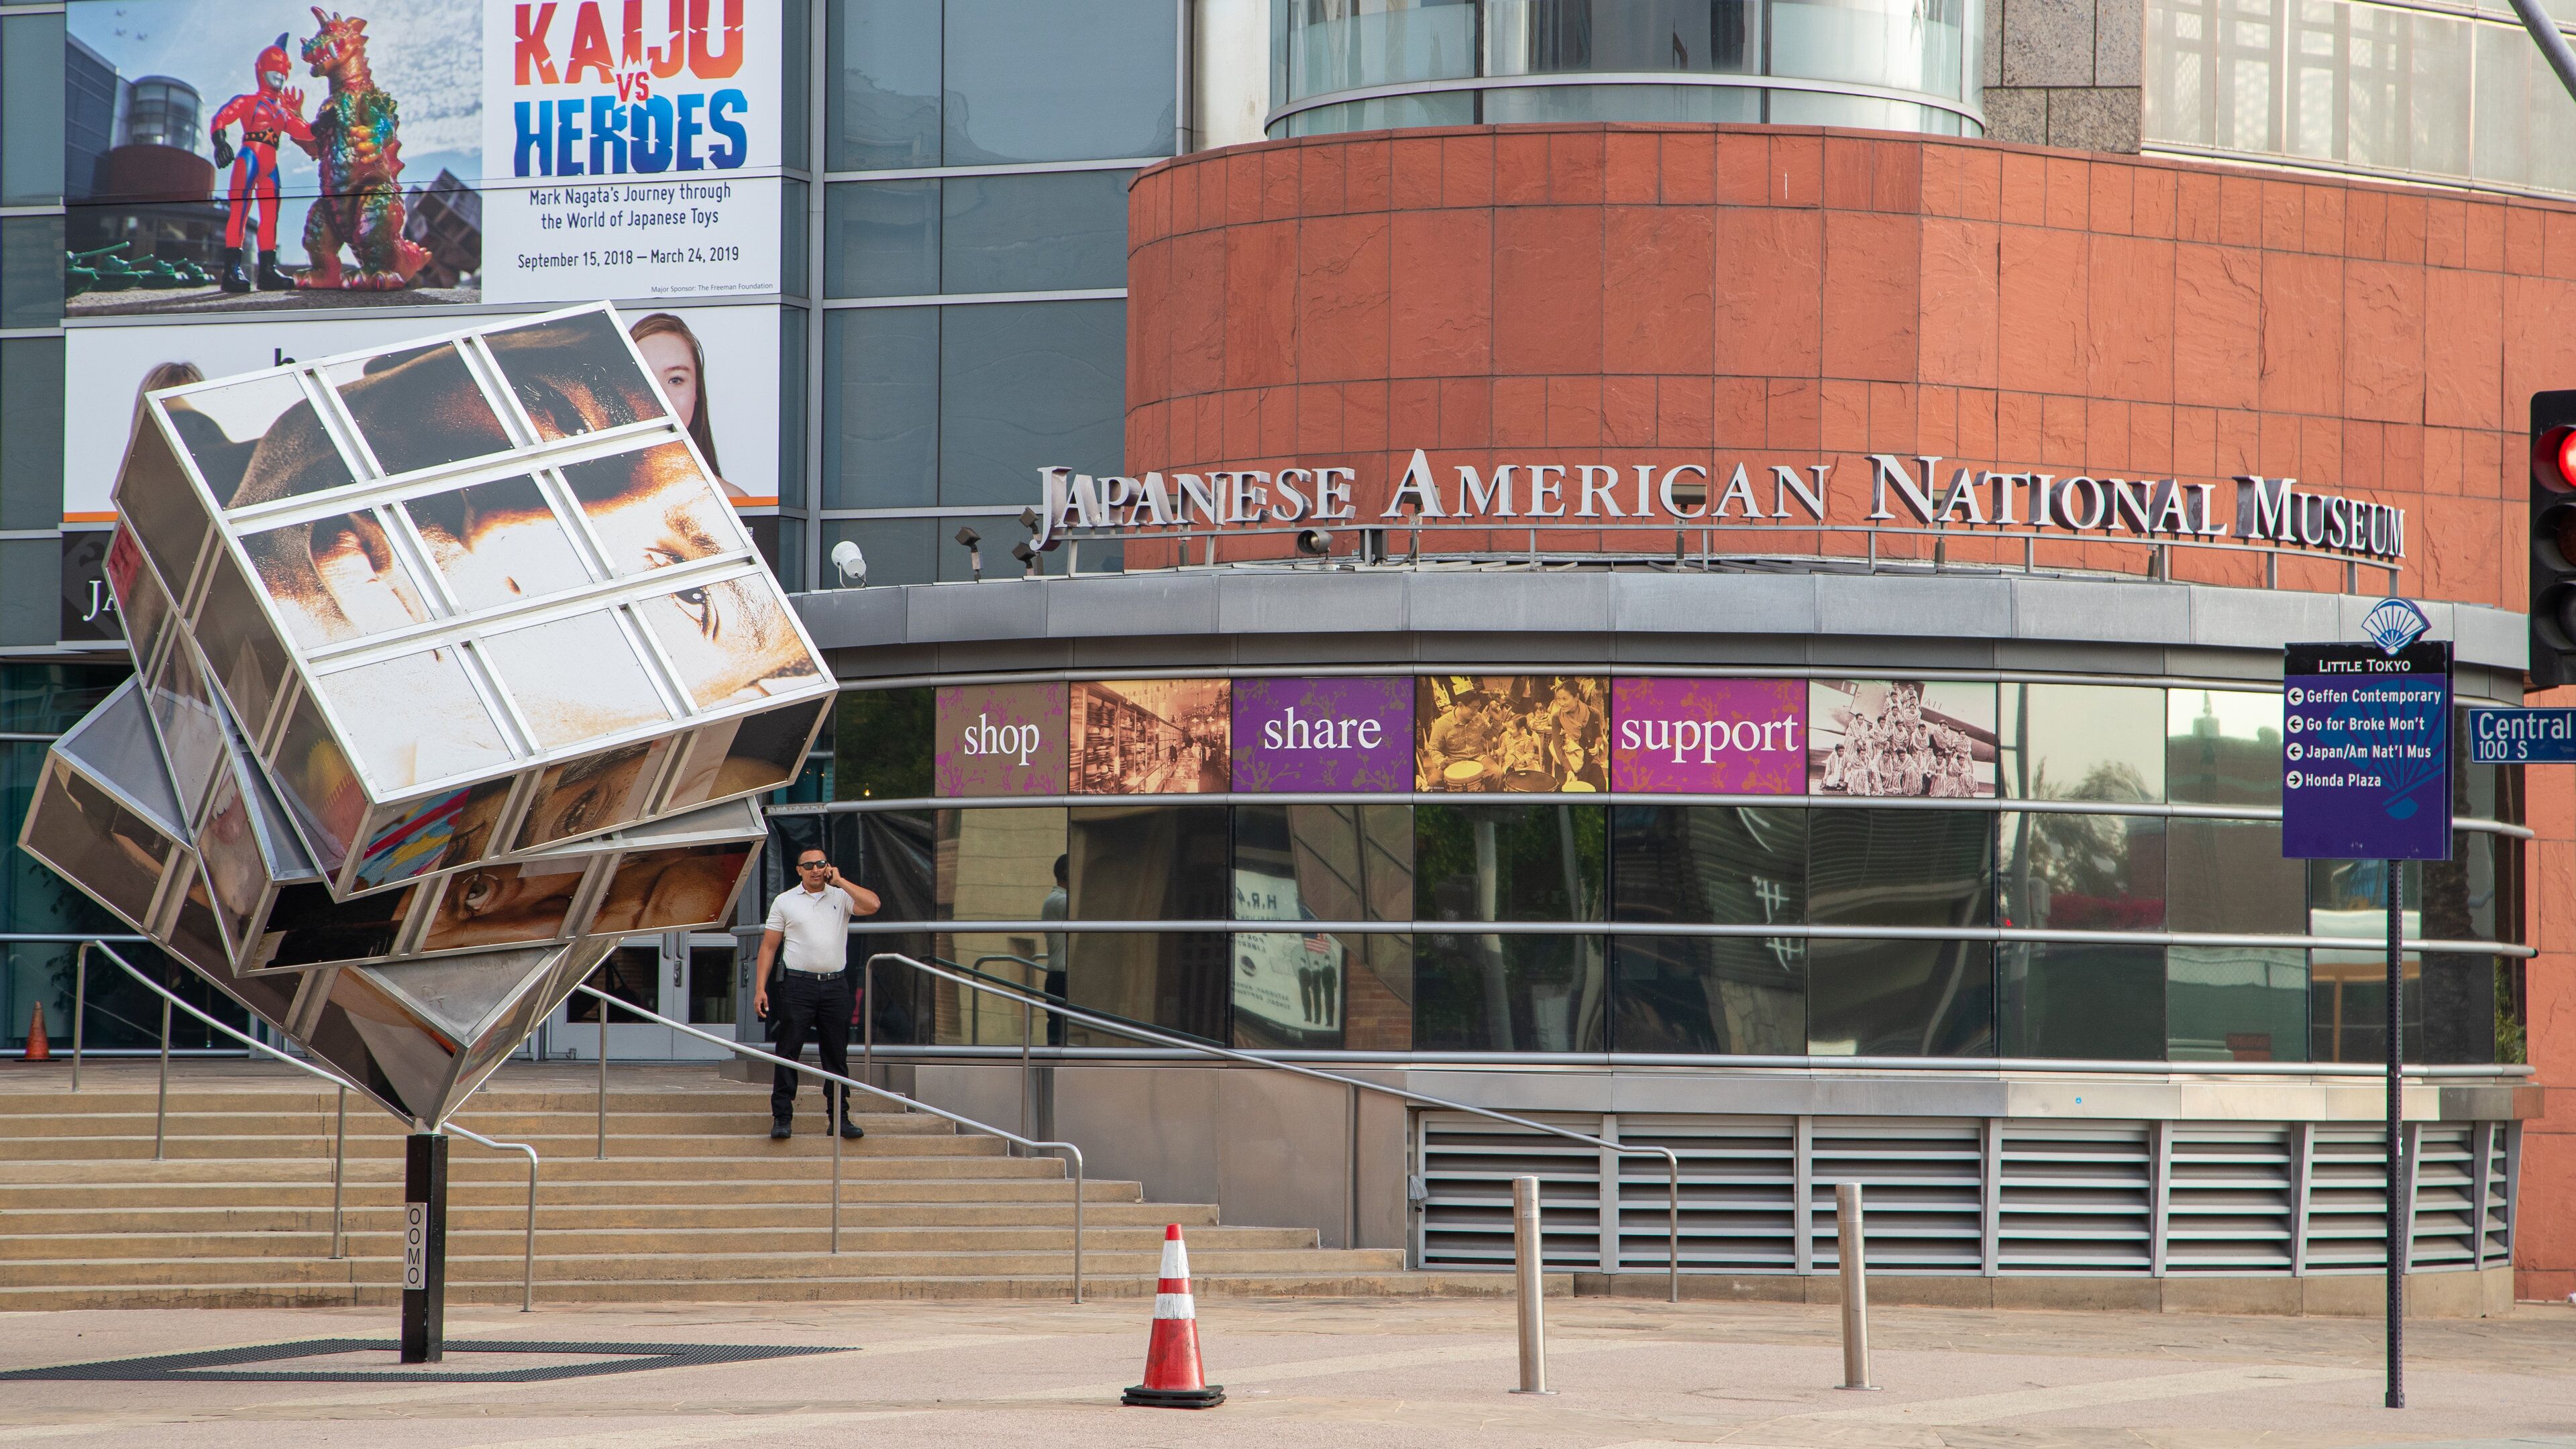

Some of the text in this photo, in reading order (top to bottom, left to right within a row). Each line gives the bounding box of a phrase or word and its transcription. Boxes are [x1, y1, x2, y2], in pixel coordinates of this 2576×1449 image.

[515, 0, 744, 86] KAIJU
[616, 70, 650, 102] VS
[514, 89, 748, 177] HEROES
[529, 181, 732, 209] Mark Nagata's Journey through
[541, 207, 718, 230] the World of Japanese Toys
[518, 252, 579, 272] September
[583, 251, 600, 267] 15,
[604, 250, 633, 266] 2018
[651, 248, 684, 264] March
[688, 248, 706, 264] 24,
[710, 246, 739, 262] 2019
[670, 284, 695, 293] Sponsor:
[738, 282, 773, 290] Foundation
[1029, 448, 2406, 559] JAPANESE AMERICAN NATIONAL MUSEUM
[2319, 659, 2411, 673] LITTLE TOKYO
[2307, 689, 2441, 705] Geffen Contemporary
[1265, 706, 1382, 749] share
[2306, 716, 2425, 731] Go for Broke Mon't
[2479, 712, 2571, 740] Central
[964, 712, 1040, 766] shop
[1621, 714, 1799, 763] support
[2306, 743, 2431, 761] Japan/Am Nat'l Mus
[2479, 740, 2528, 759] 100 S
[2306, 773, 2381, 787] Honda Plaza
[408, 1208, 421, 1285] OOMO
